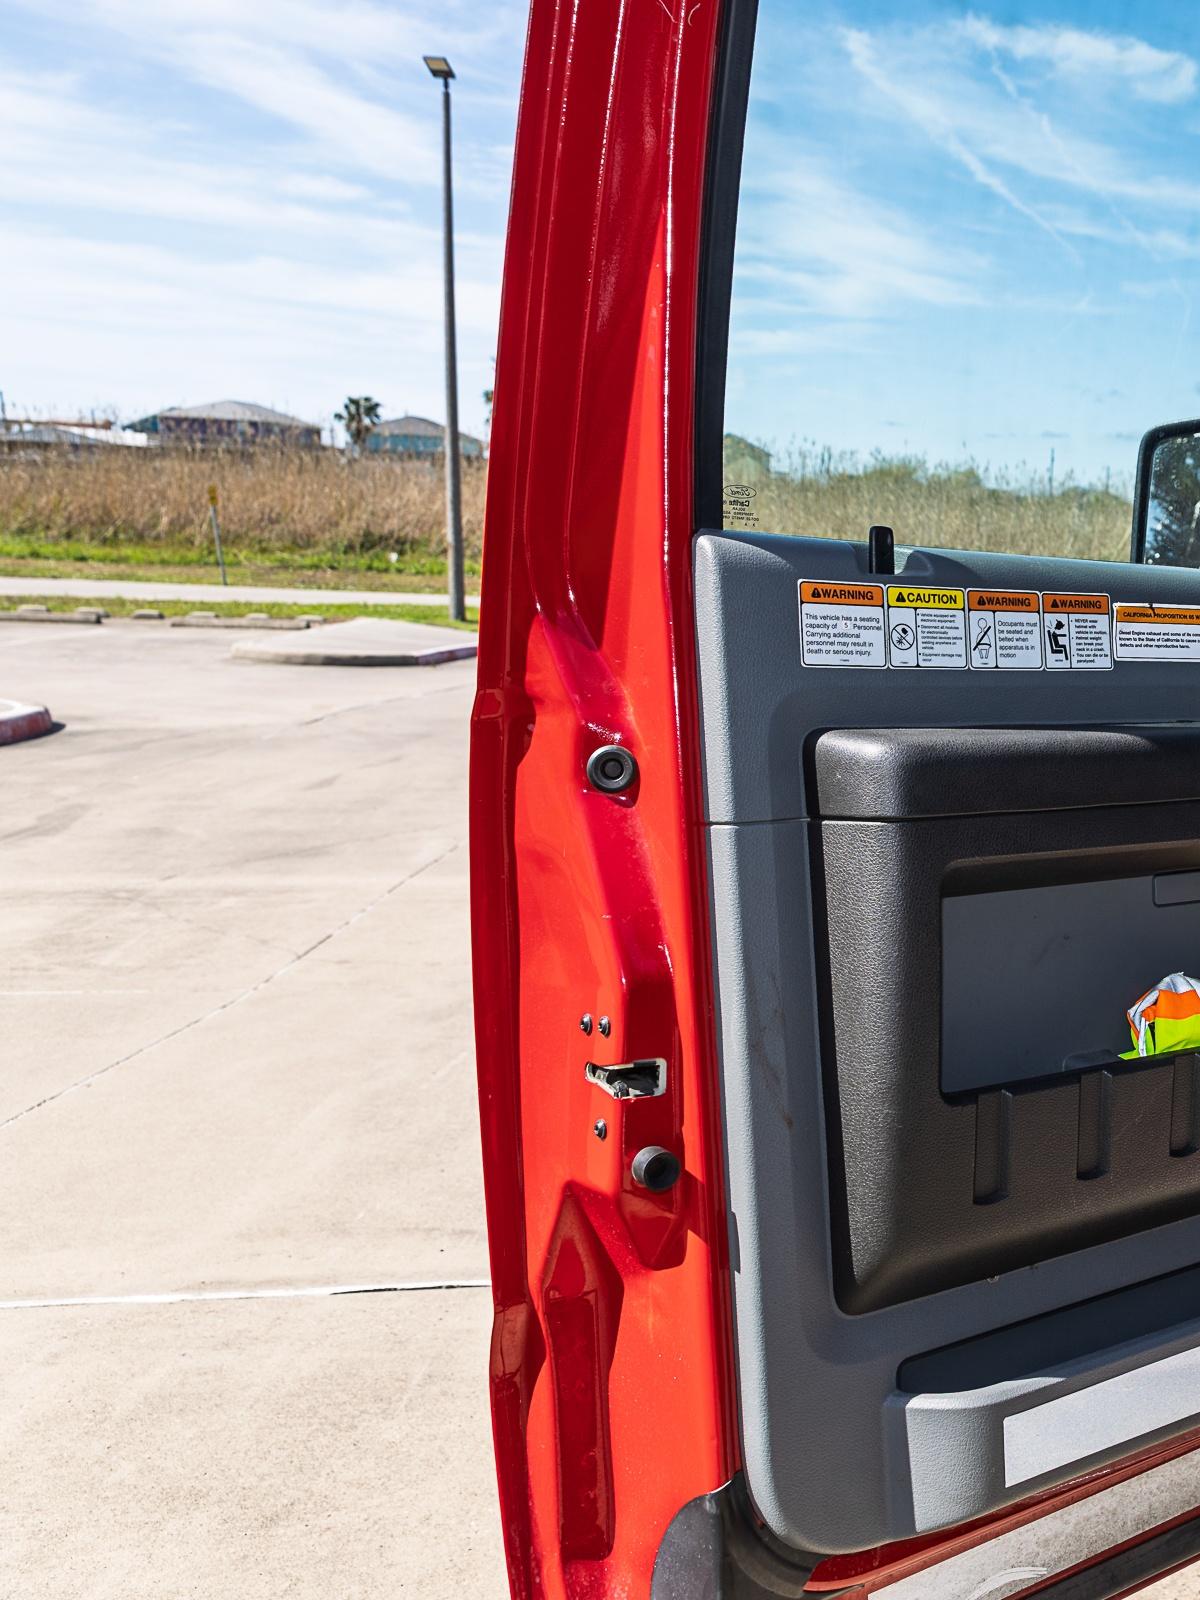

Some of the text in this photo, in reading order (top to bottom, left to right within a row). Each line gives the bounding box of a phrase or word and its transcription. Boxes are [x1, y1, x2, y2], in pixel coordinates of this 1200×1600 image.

[821, 588, 874, 600] WARNING
[907, 593, 957, 605] CAUTION
[986, 597, 1031, 607] WARNING
[1060, 600, 1102, 609] WARNING
[806, 631, 831, 639] Carrying
